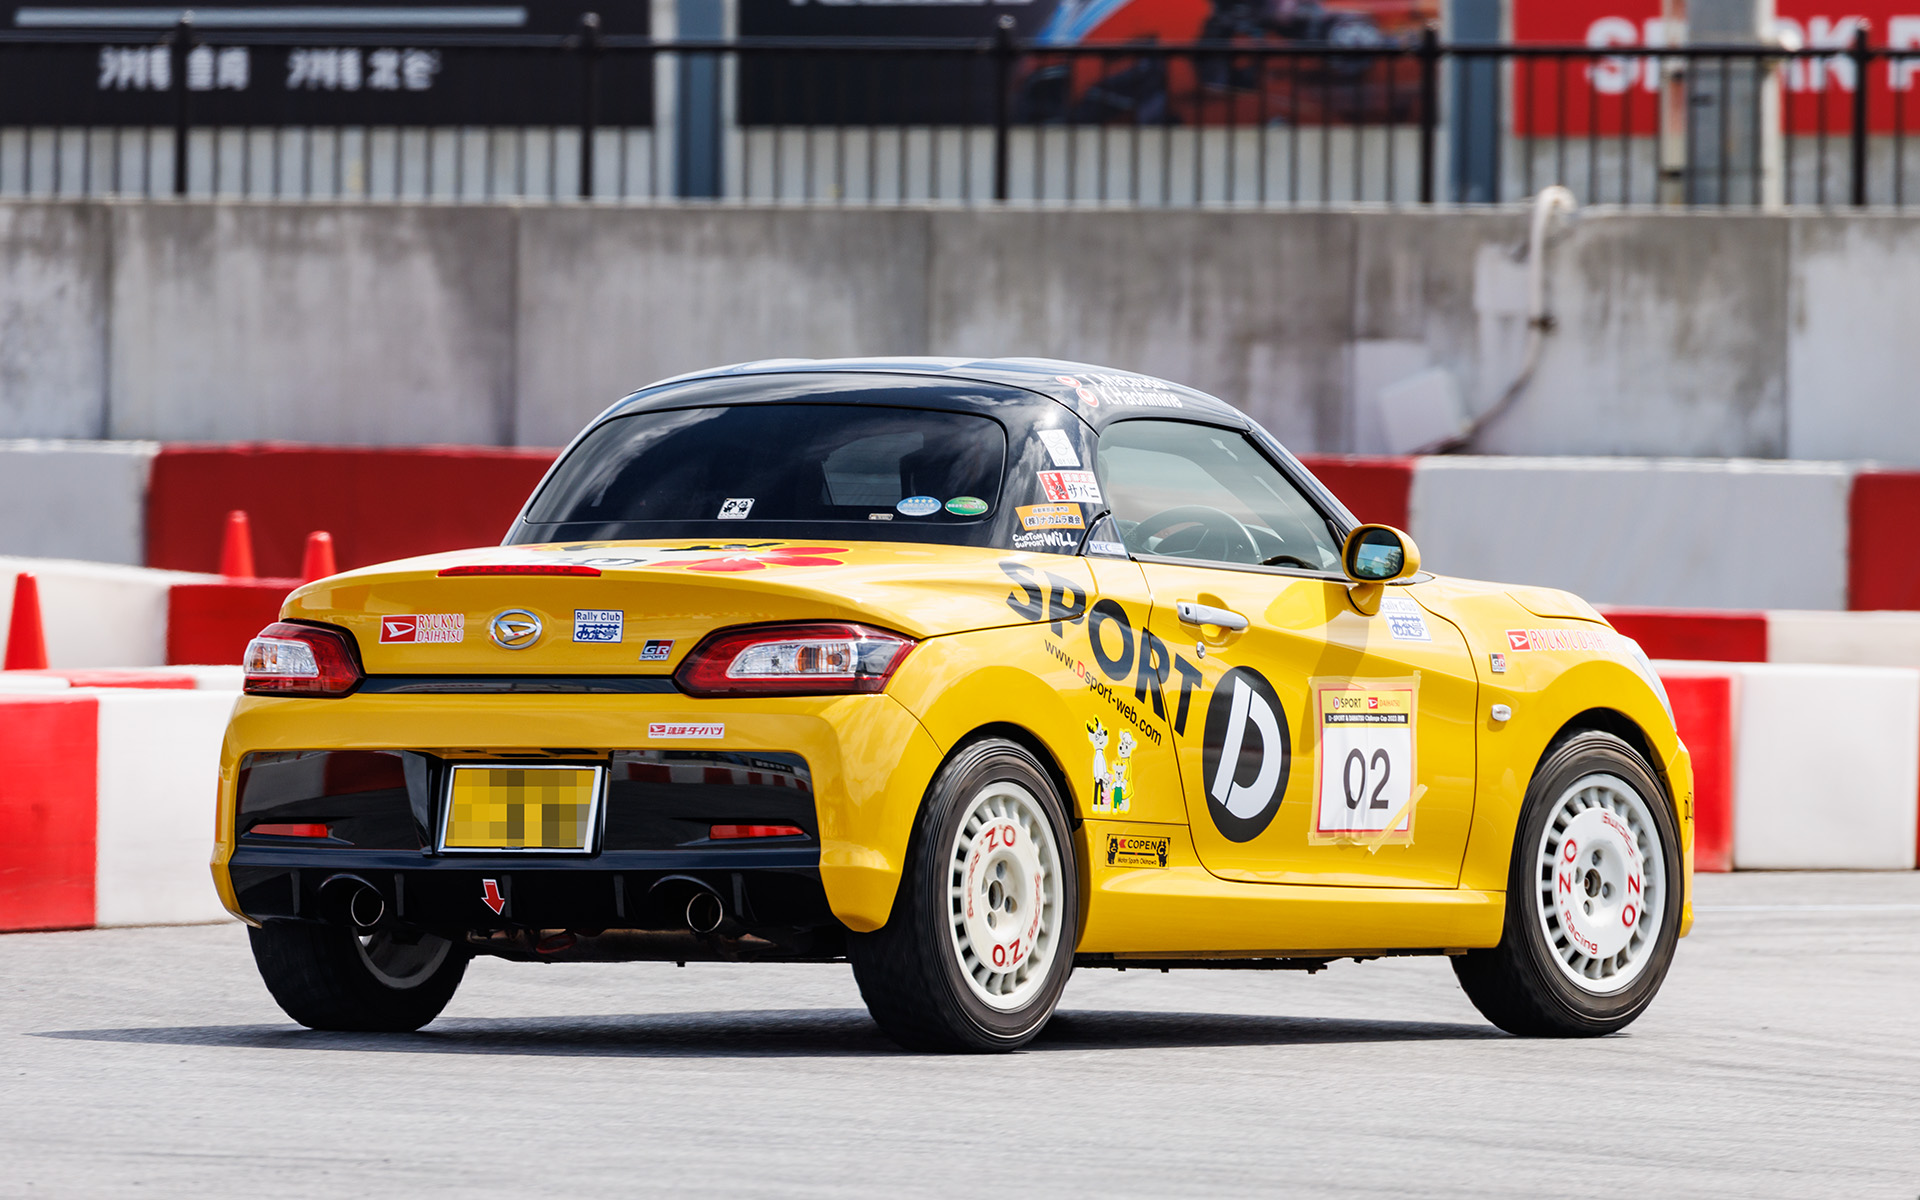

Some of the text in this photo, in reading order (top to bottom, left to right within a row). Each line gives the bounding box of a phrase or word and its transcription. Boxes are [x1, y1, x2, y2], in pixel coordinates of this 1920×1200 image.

[1095, 386, 1183, 408] K.Hachimine
[1067, 484, 1099, 498] サバニ
[418, 614, 464, 629] RYUKYU
[576, 611, 621, 623] Rally Club
[417, 629, 464, 642] DAIHATSU
[1529, 629, 1578, 650] RYUKYU
[643, 645, 671, 654] GR
[998, 561, 1203, 738] SPORT
[1044, 639, 1162, 746] www.Dsport-web.com
[1341, 698, 1361, 708] SPORT
[667, 726, 723, 736] 琉球ダイハツ
[1343, 747, 1391, 810] 02
[1127, 839, 1157, 850] COPEN
[1564, 910, 1598, 955] Racing
